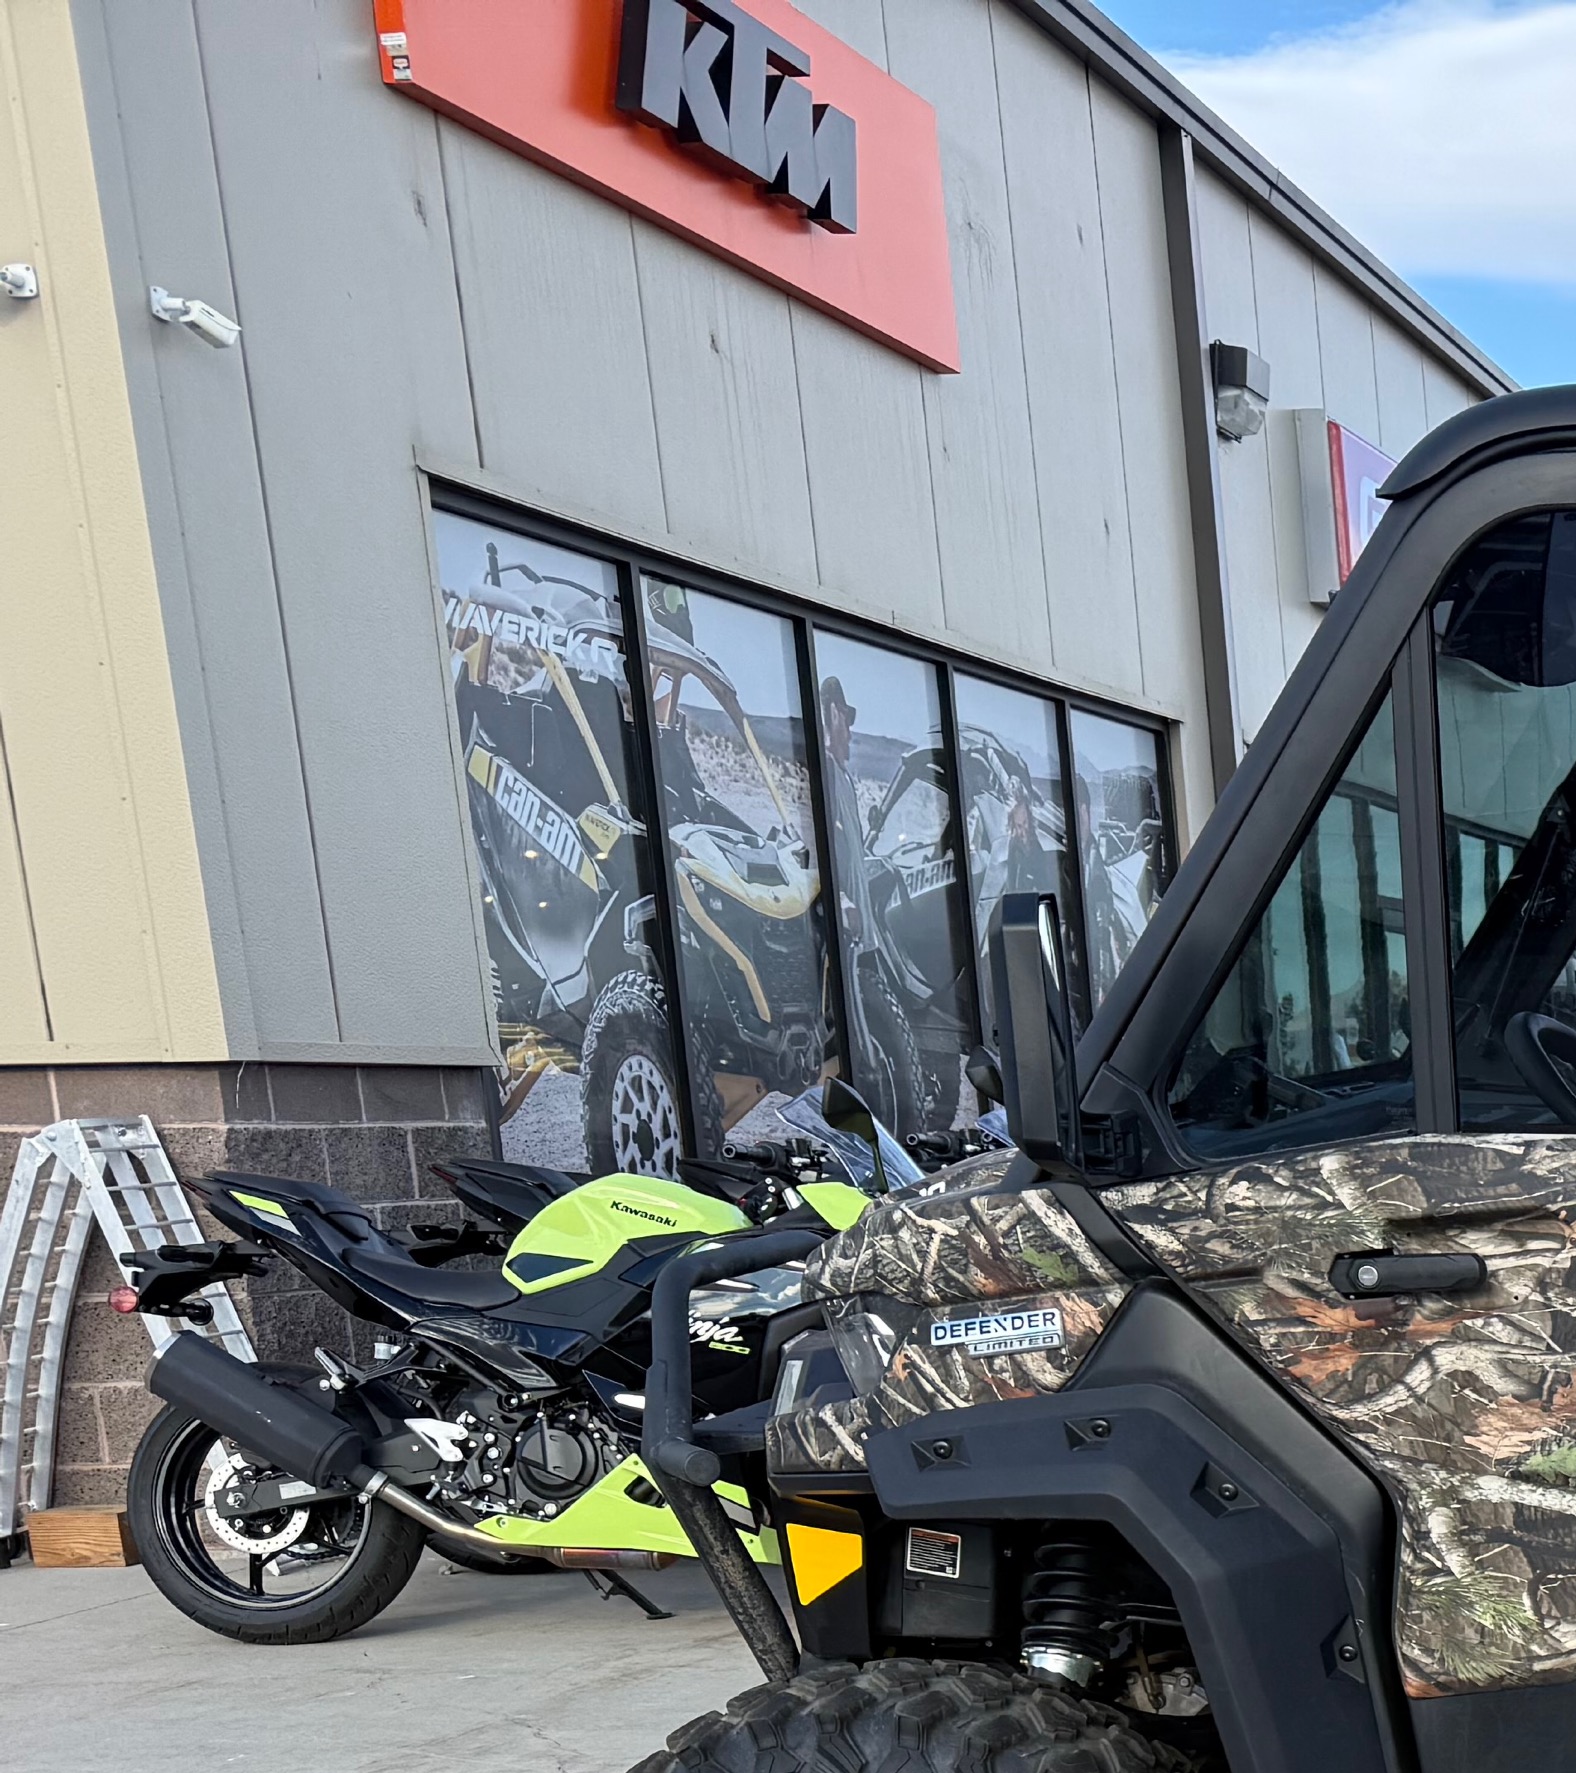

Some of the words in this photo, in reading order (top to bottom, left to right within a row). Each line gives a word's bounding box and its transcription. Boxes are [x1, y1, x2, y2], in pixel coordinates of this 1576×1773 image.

[640, 0, 857, 235] KTM
[494, 766, 583, 875] can-am
[905, 860, 956, 896] an-am
[610, 1200, 678, 1228] Kawasaki
[934, 1311, 1056, 1341] DEFENDER
[973, 1336, 1054, 1352] LIMITED
